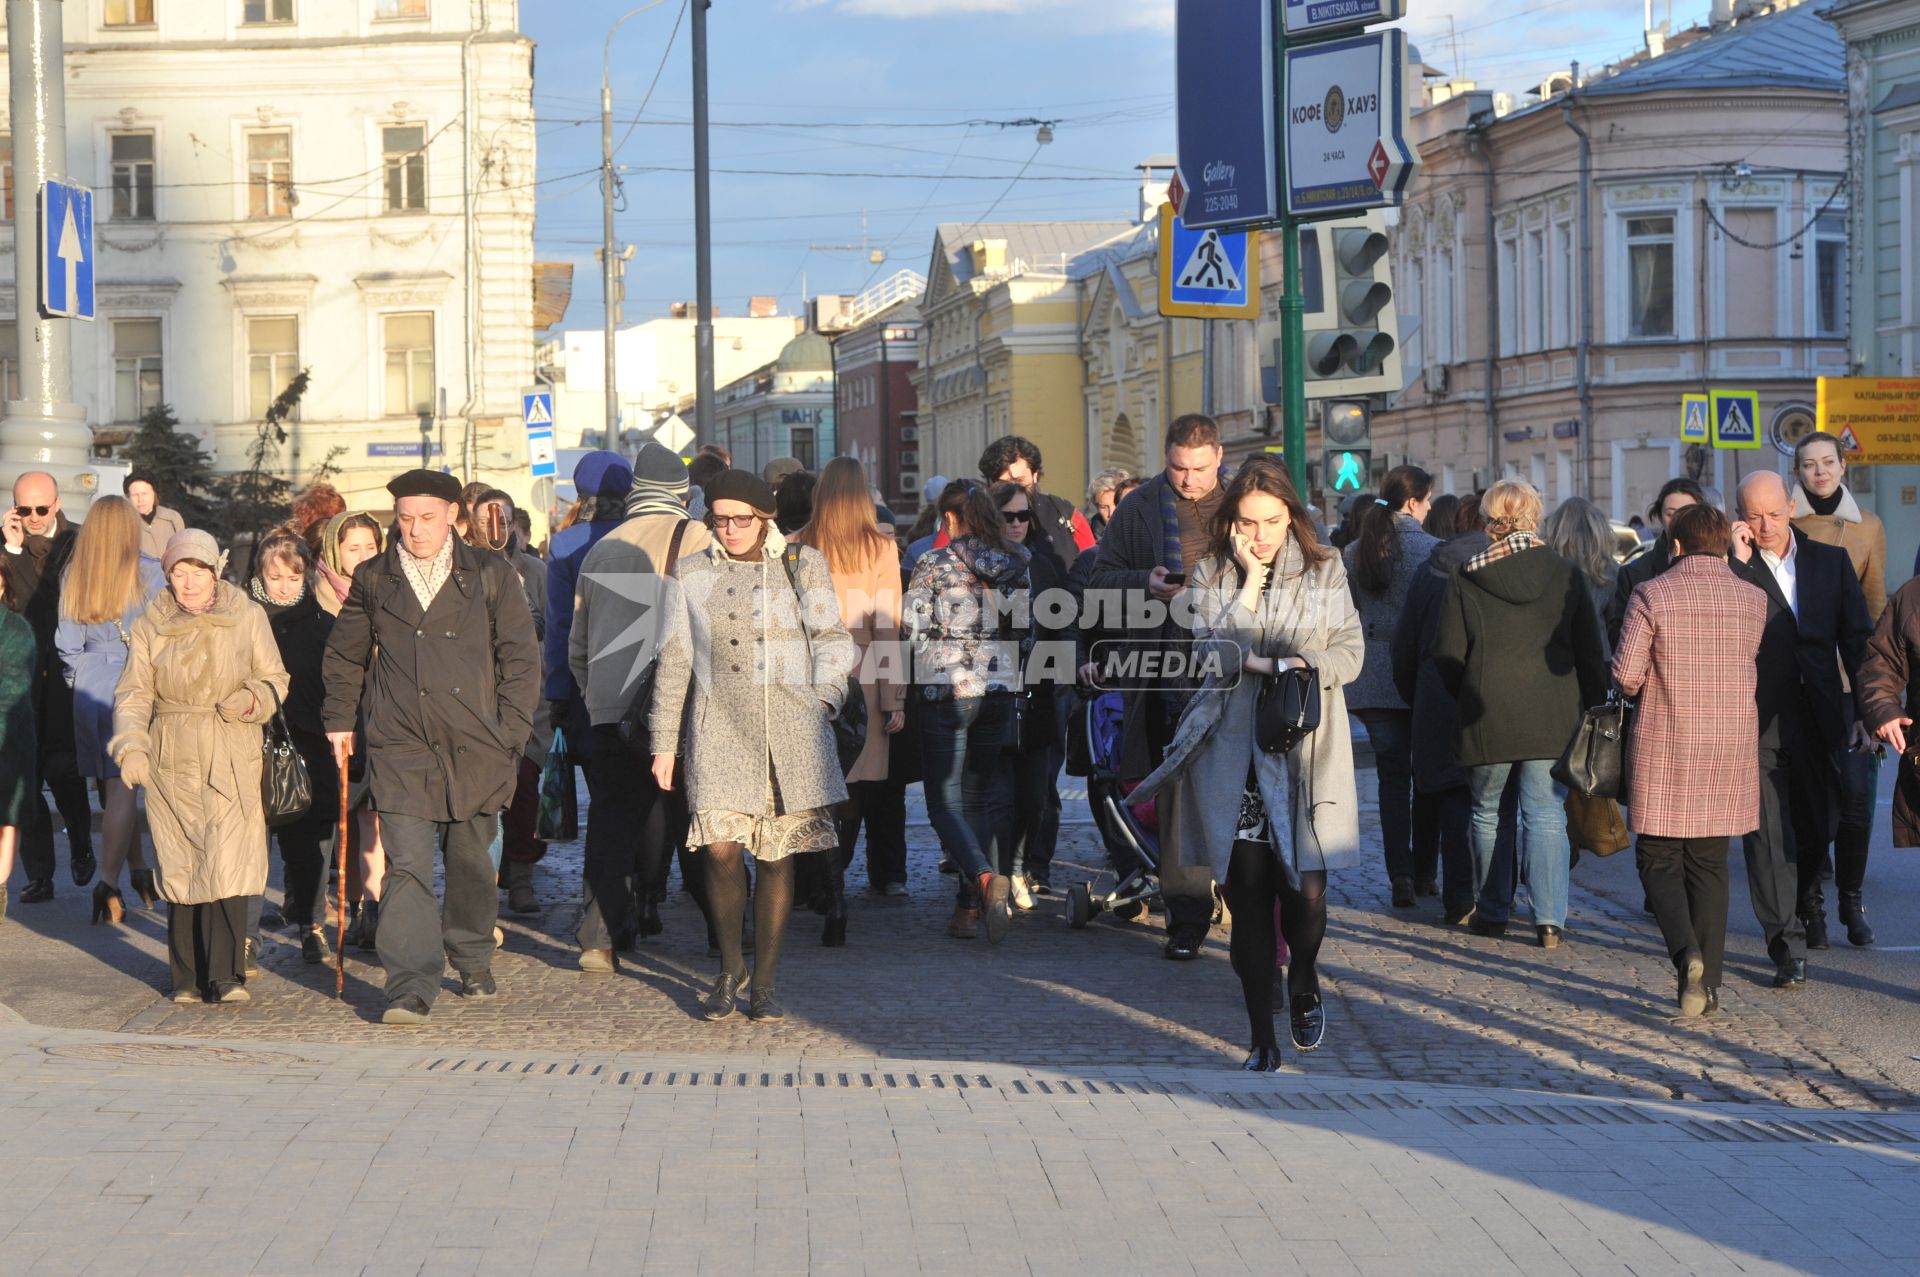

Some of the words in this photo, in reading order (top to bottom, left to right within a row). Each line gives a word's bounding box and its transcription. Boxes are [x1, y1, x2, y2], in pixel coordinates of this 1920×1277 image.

[1311, 1, 1359, 20] B.NIKITSKAYA
[1361, 1, 1376, 11] street
[1292, 103, 1321, 125] КОФЕ
[1347, 93, 1377, 116] ХАУЗ
[1323, 152, 1330, 162] 24
[1330, 150, 1345, 161] ЧАСА
[1203, 160, 1235, 187] Gallery
[1204, 194, 1238, 213] 225-2040
[782, 408, 823, 425] БАНК
[1876, 433, 1910, 443] ОБЪЕЗД
